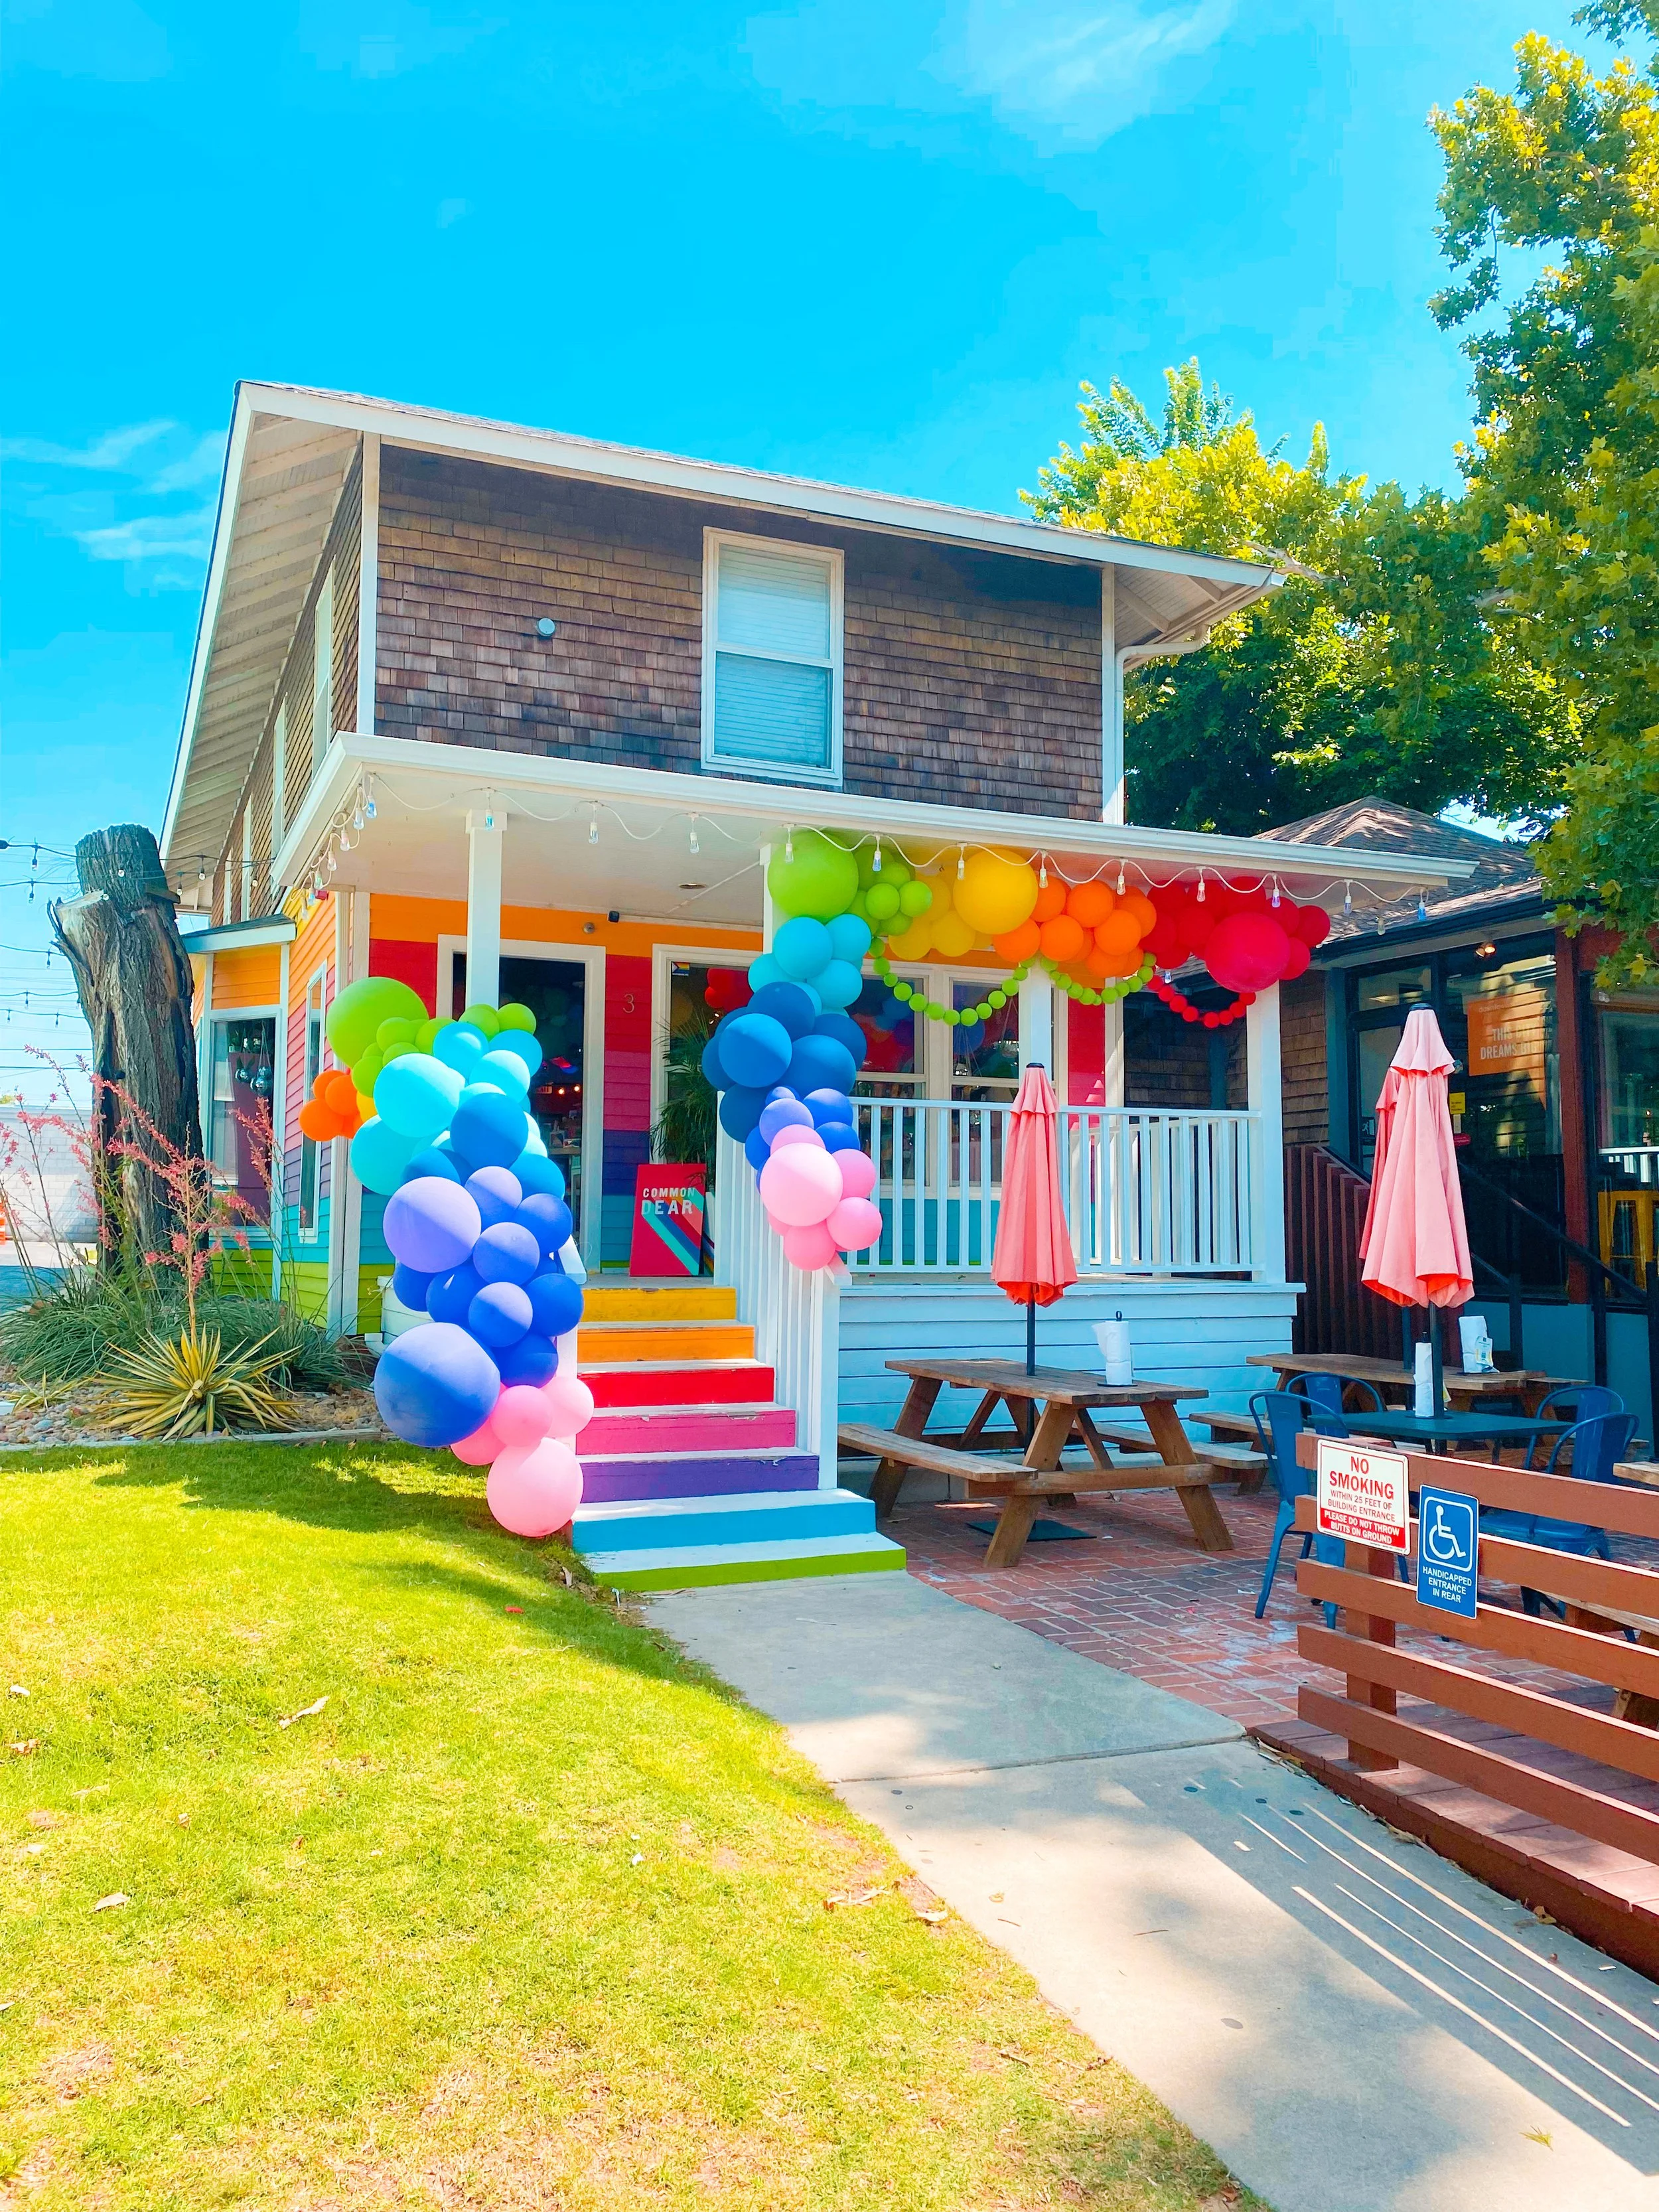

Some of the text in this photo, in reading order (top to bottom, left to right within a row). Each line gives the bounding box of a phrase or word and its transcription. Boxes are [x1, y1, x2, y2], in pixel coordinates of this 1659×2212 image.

[622, 994, 635, 1013] 3
[1492, 1027, 1513, 1041] THIS
[1480, 1043, 1516, 1060] DREAMS
[643, 1187, 695, 1198] COMMON
[642, 1200, 692, 1215] DEAR
[1350, 1456, 1369, 1474] NO
[1329, 1471, 1394, 1500] SMOKING
[1331, 1489, 1392, 1511] WITHIN 25 FEET OF
[1328, 1499, 1395, 1522] BUILDING ENTRANCE
[1324, 1510, 1400, 1536] PLEASE DO NOT THROW
[1331, 1522, 1350, 1534] BUTTS
[1351, 1527, 1361, 1537] ON
[1362, 1530, 1392, 1544] GROUND
[1423, 1566, 1472, 1587] HANDICAPPED
[1428, 1577, 1467, 1595] ENTRANCE
[1433, 1587, 1461, 1603] IN REAR
